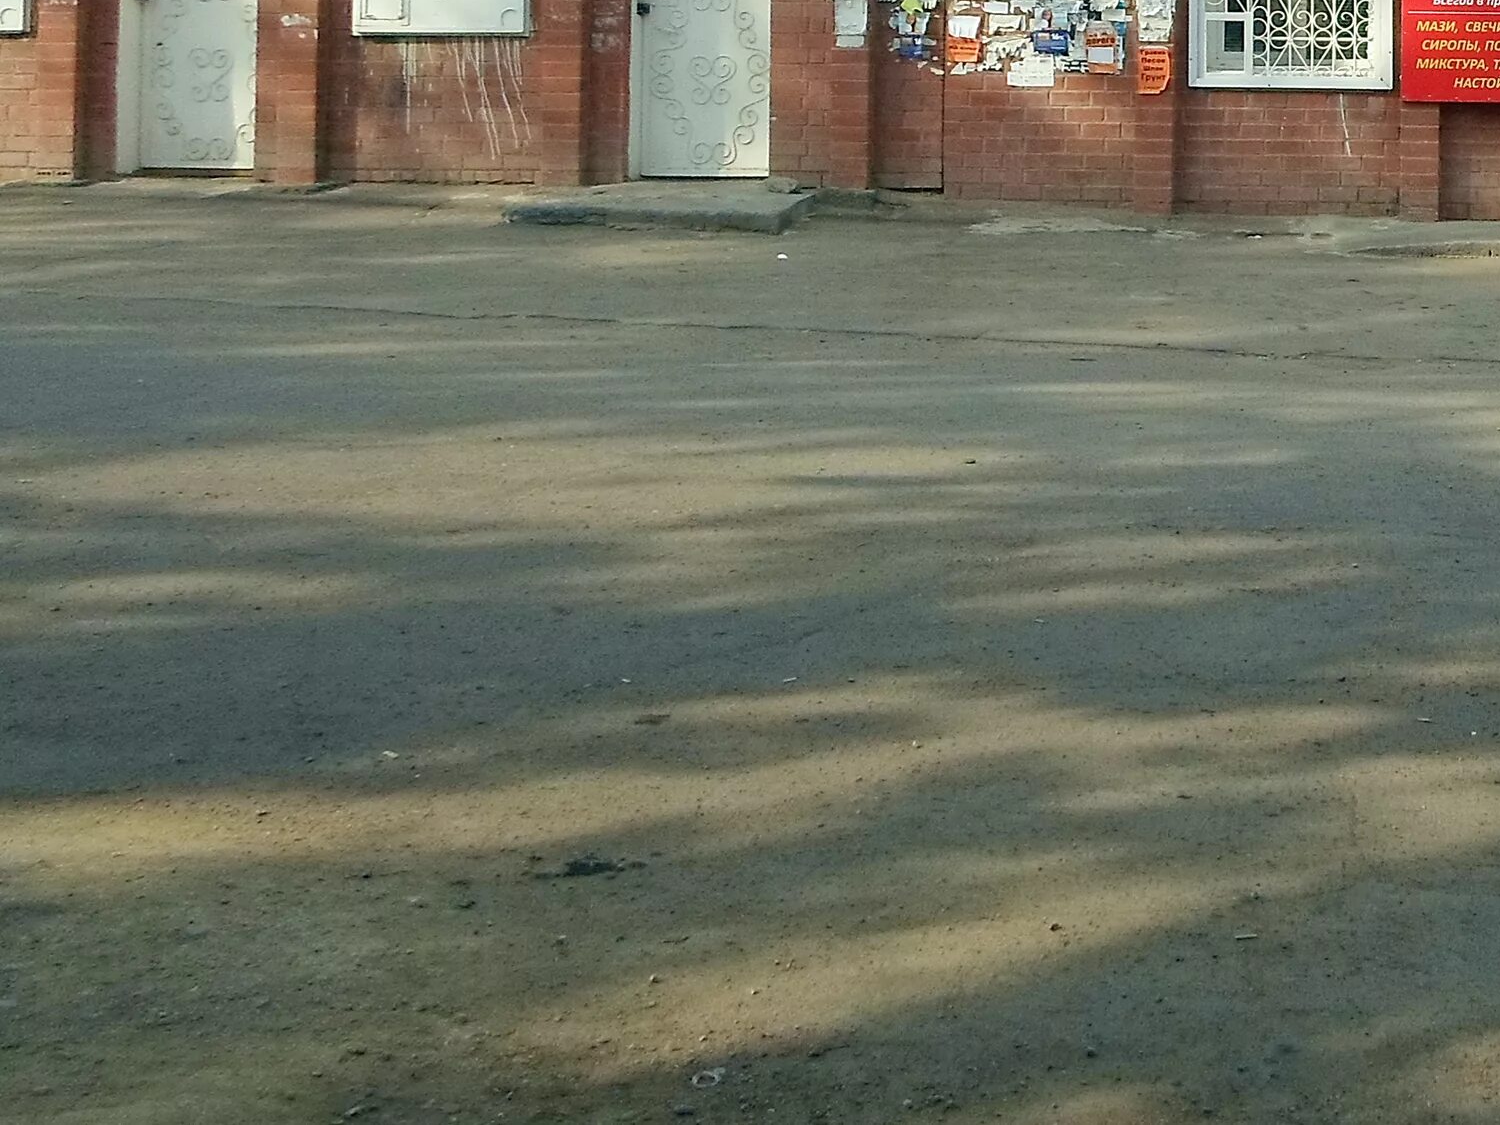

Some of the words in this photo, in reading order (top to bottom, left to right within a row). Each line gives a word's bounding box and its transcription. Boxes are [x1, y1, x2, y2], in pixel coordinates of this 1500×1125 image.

[1416, 21, 1459, 34] МАЗИ,
[1421, 39, 1481, 53] СИРОПЫ,
[1416, 58, 1489, 71] МИКСТУРА,
